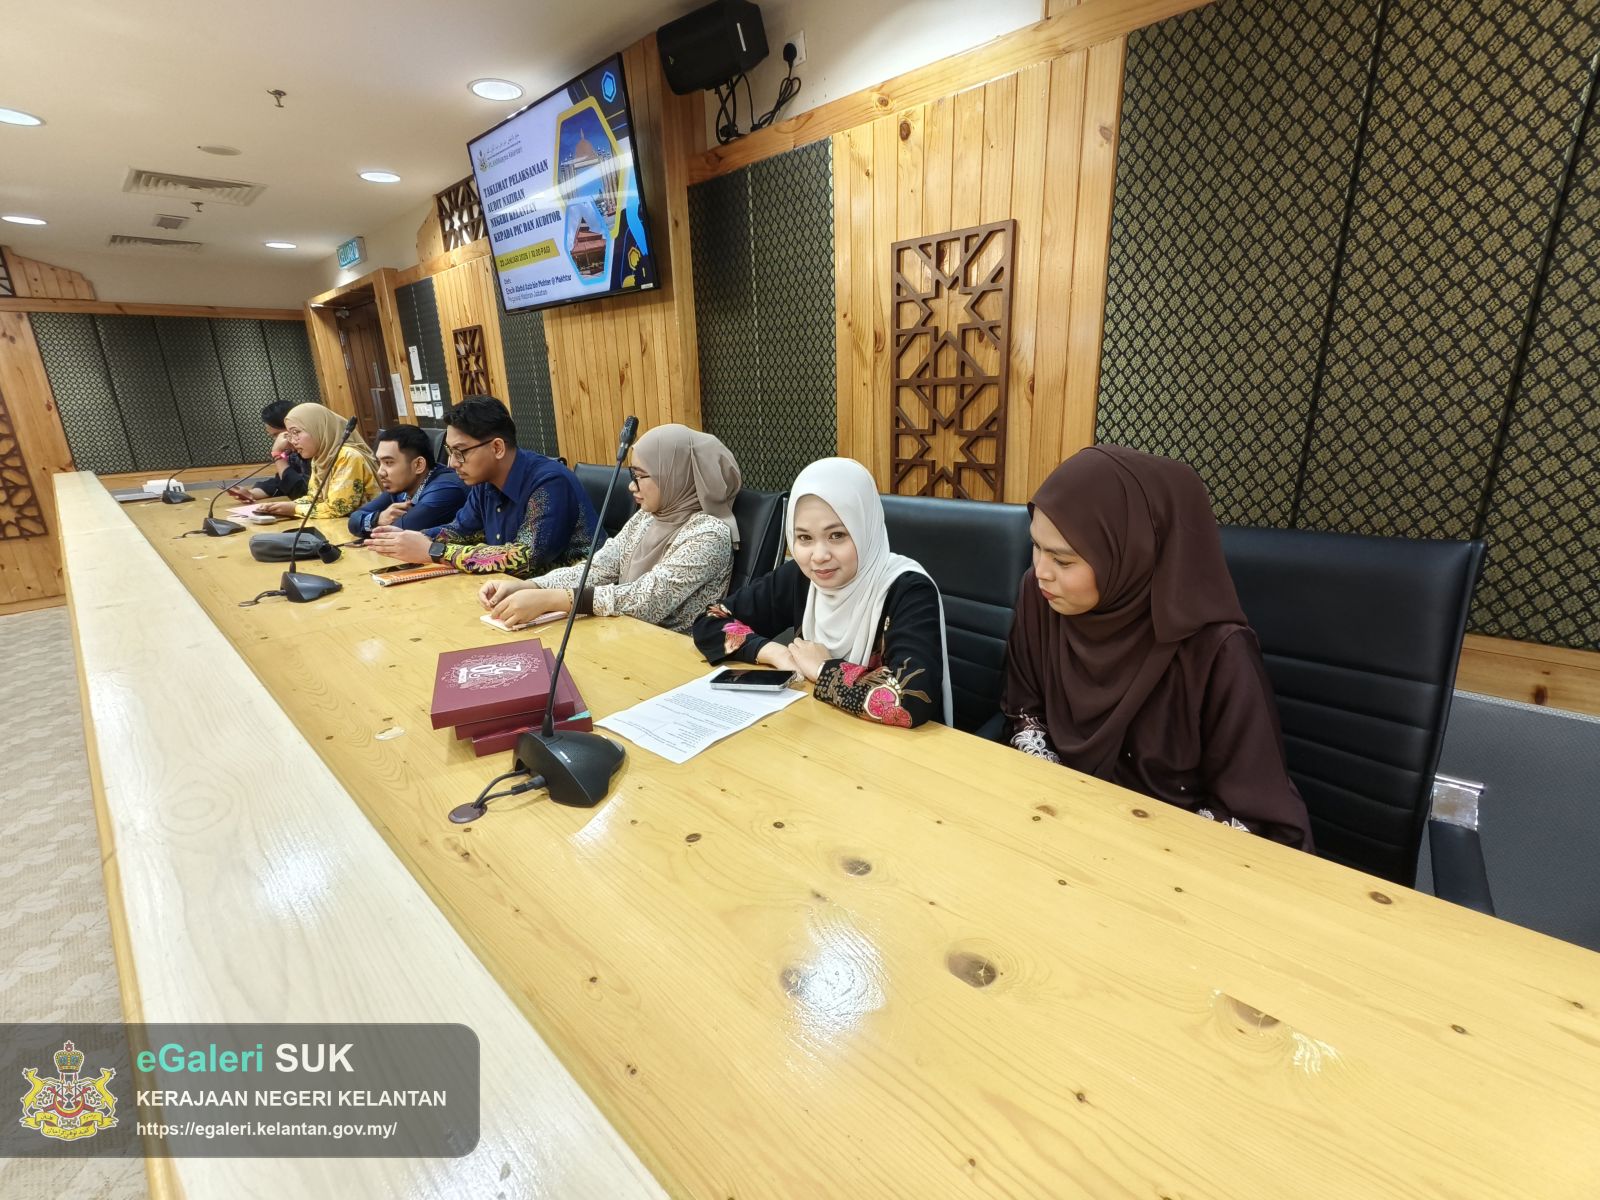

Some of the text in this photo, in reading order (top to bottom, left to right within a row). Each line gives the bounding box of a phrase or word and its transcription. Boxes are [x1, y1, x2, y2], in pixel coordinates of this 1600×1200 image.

[483, 158, 549, 198] TAKLIMAT PELAKSANAAN
[487, 187, 525, 213] AUDIT NAZIRAN
[489, 211, 509, 228] NEGERI
[493, 210, 562, 243] KEPADA PIC DAN AUDITOR
